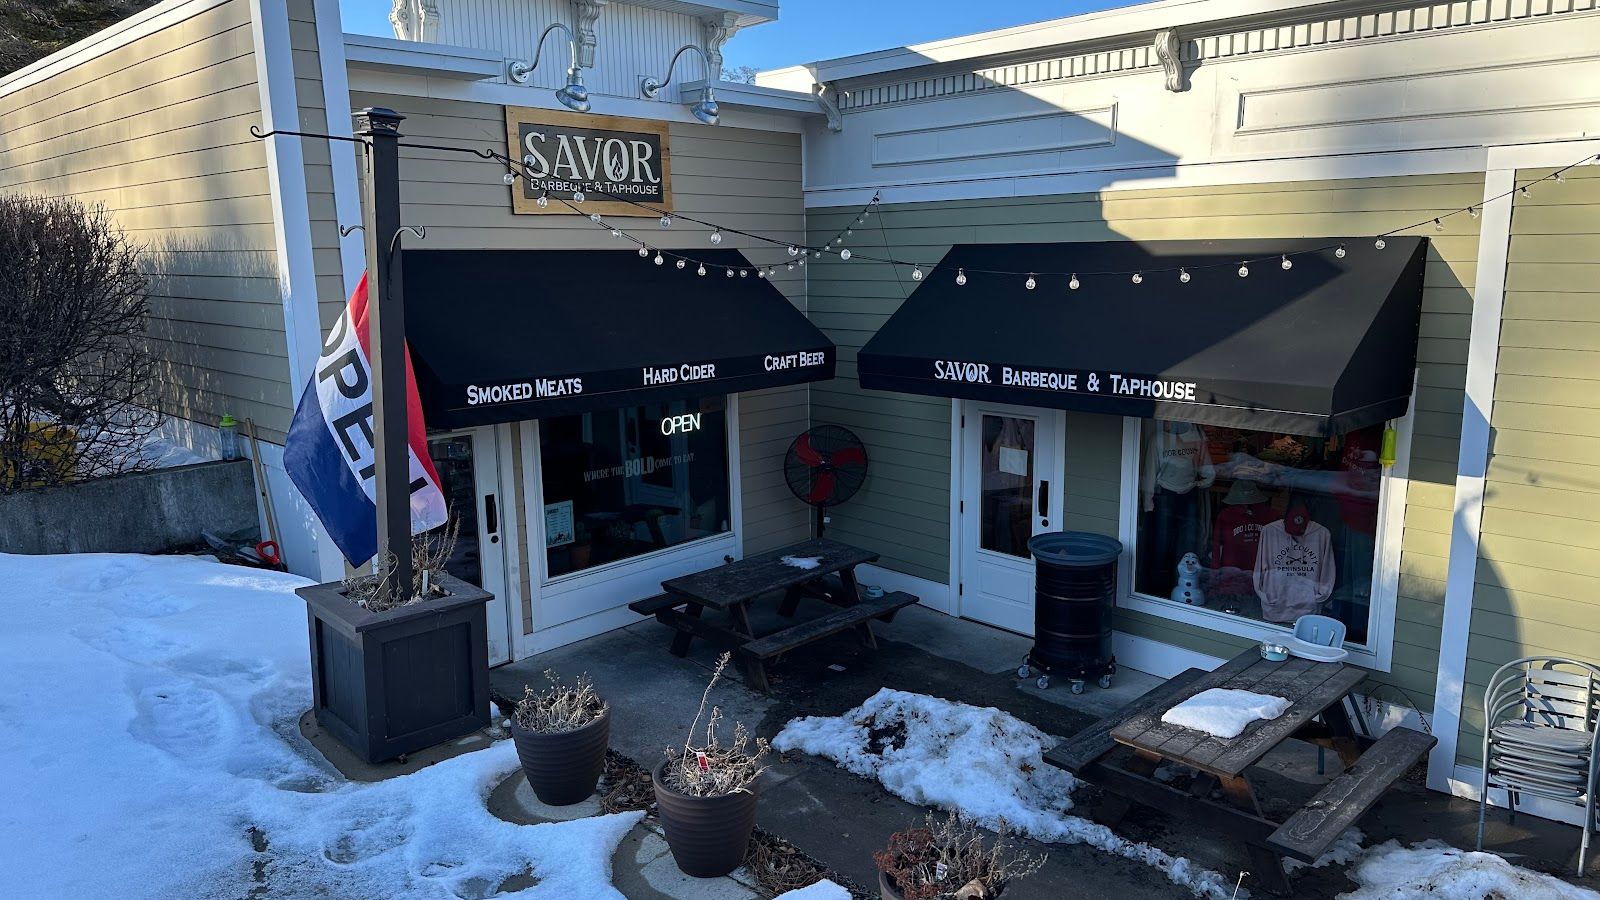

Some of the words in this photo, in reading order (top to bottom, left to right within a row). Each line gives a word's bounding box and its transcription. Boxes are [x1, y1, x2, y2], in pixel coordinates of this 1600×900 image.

[525, 131, 660, 183] SAVOR
[594, 181, 603, 193] &
[605, 181, 659, 195] TAPHOUSE
[764, 354, 798, 371] CRAFT
[799, 351, 825, 367] BEER
[643, 367, 678, 385] HARD
[680, 363, 716, 381] CIDER
[934, 360, 992, 383] SAVOR
[1002, 366, 1078, 390] BARBEQUE
[1087, 372, 1100, 392] &
[1109, 374, 1197, 401] TAPHOUSE
[467, 383, 532, 405] SMOKED
[536, 377, 582, 398] MEATS
[661, 412, 701, 436] OPEN
[584, 468, 610, 482] WHERE
[625, 456, 655, 478] BOLD
[674, 455, 682, 464] TO
[1293, 544, 1320, 566] COUNTY
